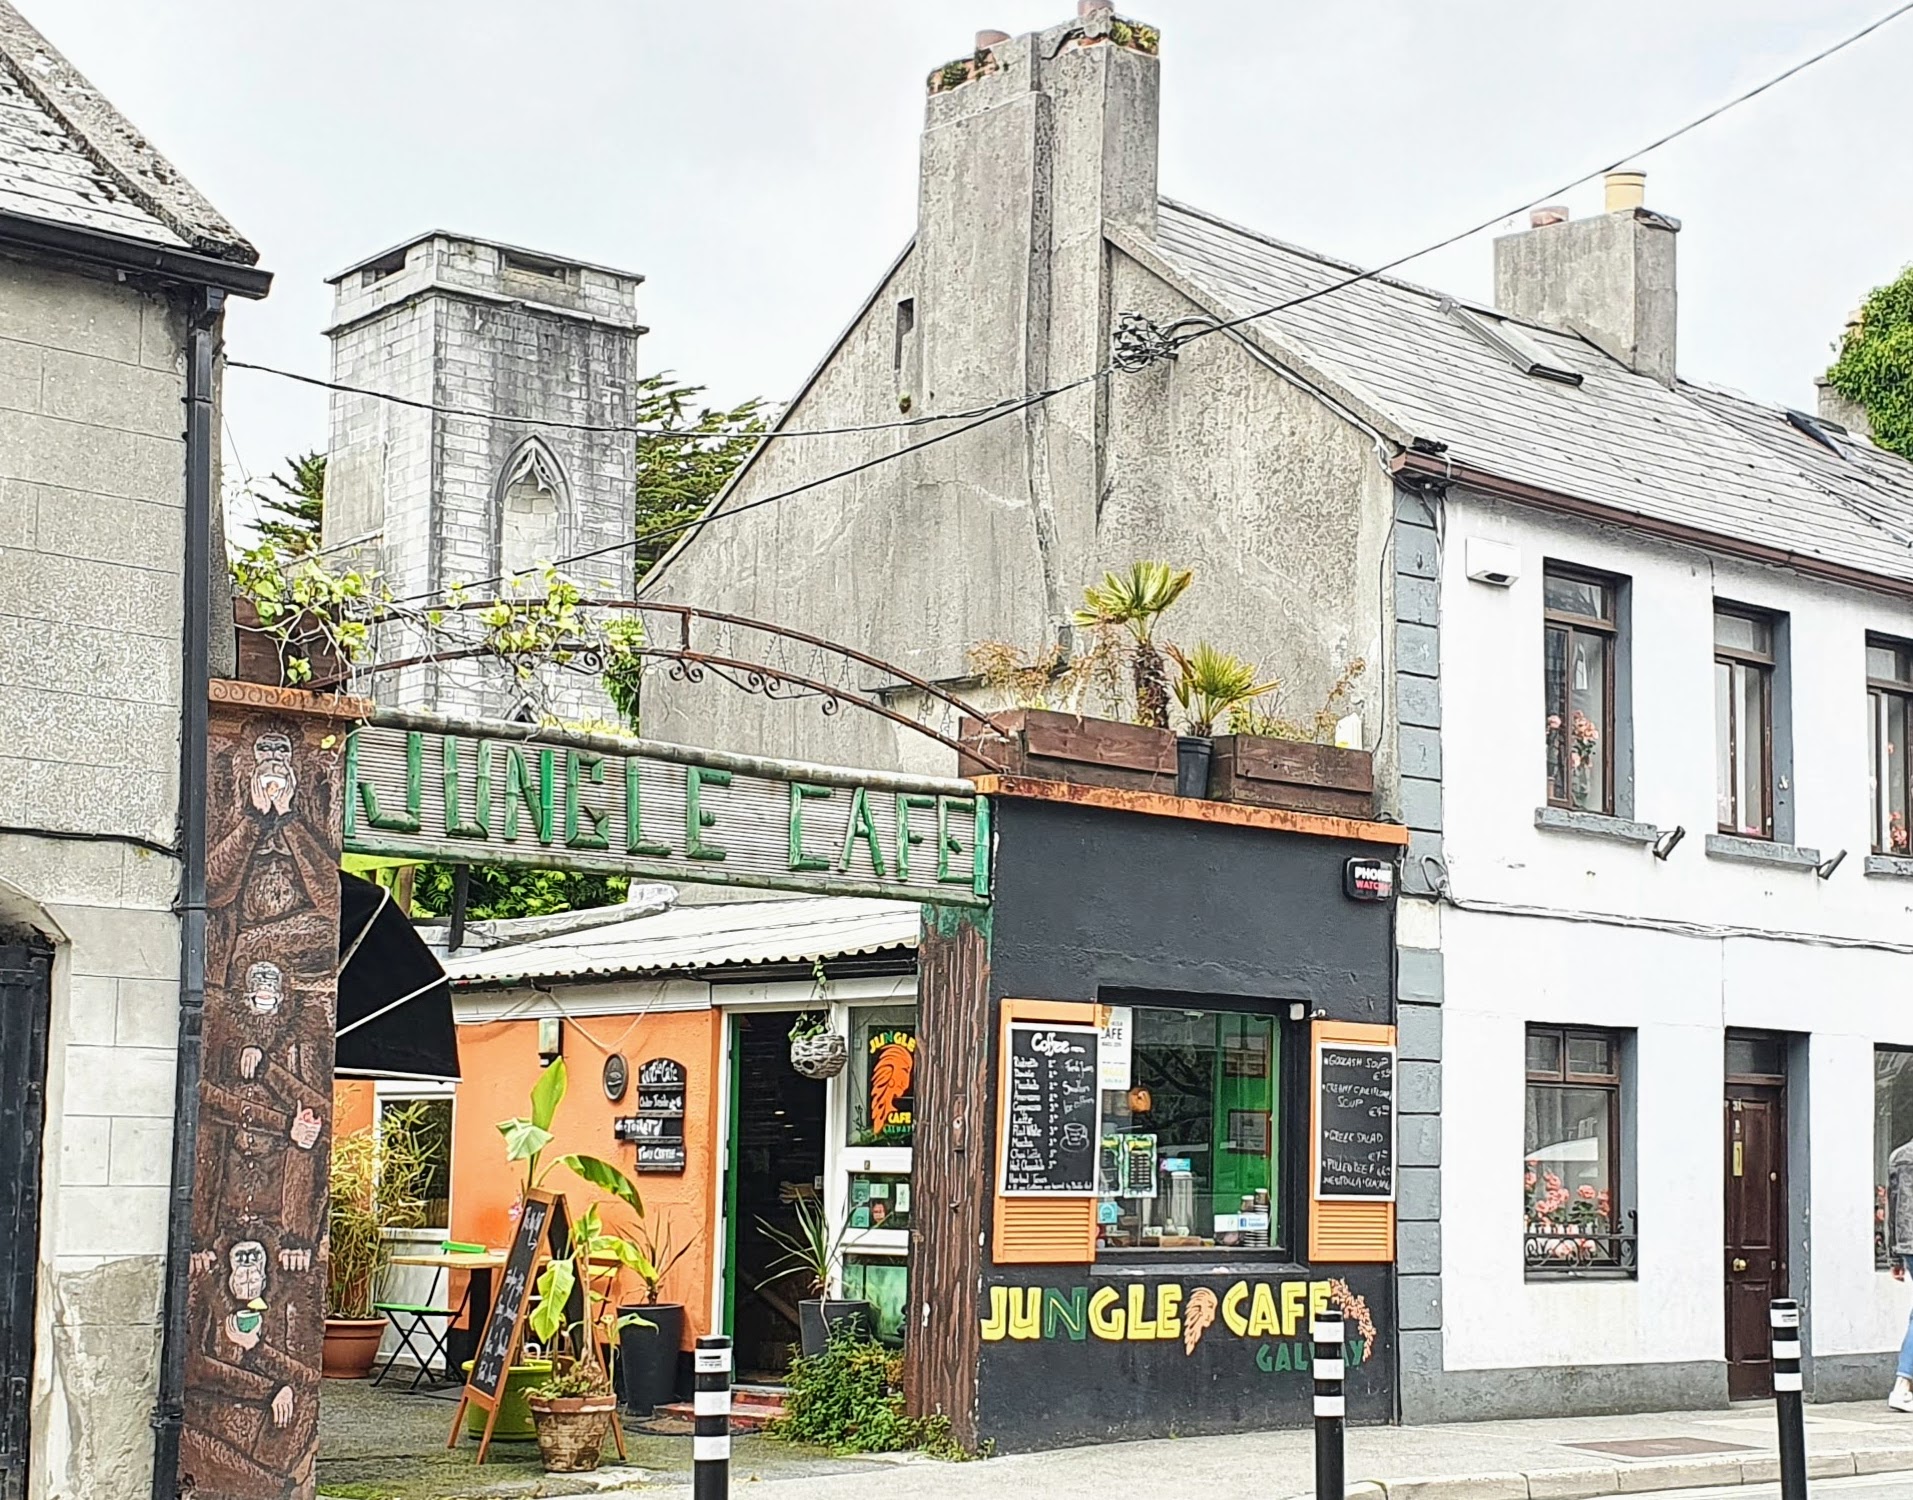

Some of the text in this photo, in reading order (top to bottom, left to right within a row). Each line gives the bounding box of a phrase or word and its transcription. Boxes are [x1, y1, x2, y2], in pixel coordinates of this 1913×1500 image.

[359, 731, 975, 884] JUNGLE CAFE
[869, 1028, 916, 1054] JUNGLE
[1031, 1032, 1071, 1057] Coffee
[888, 1111, 912, 1124] CAFE
[980, 1280, 1332, 1341] JUNGLE CAFE
[1256, 1340, 1364, 1372] GALY
